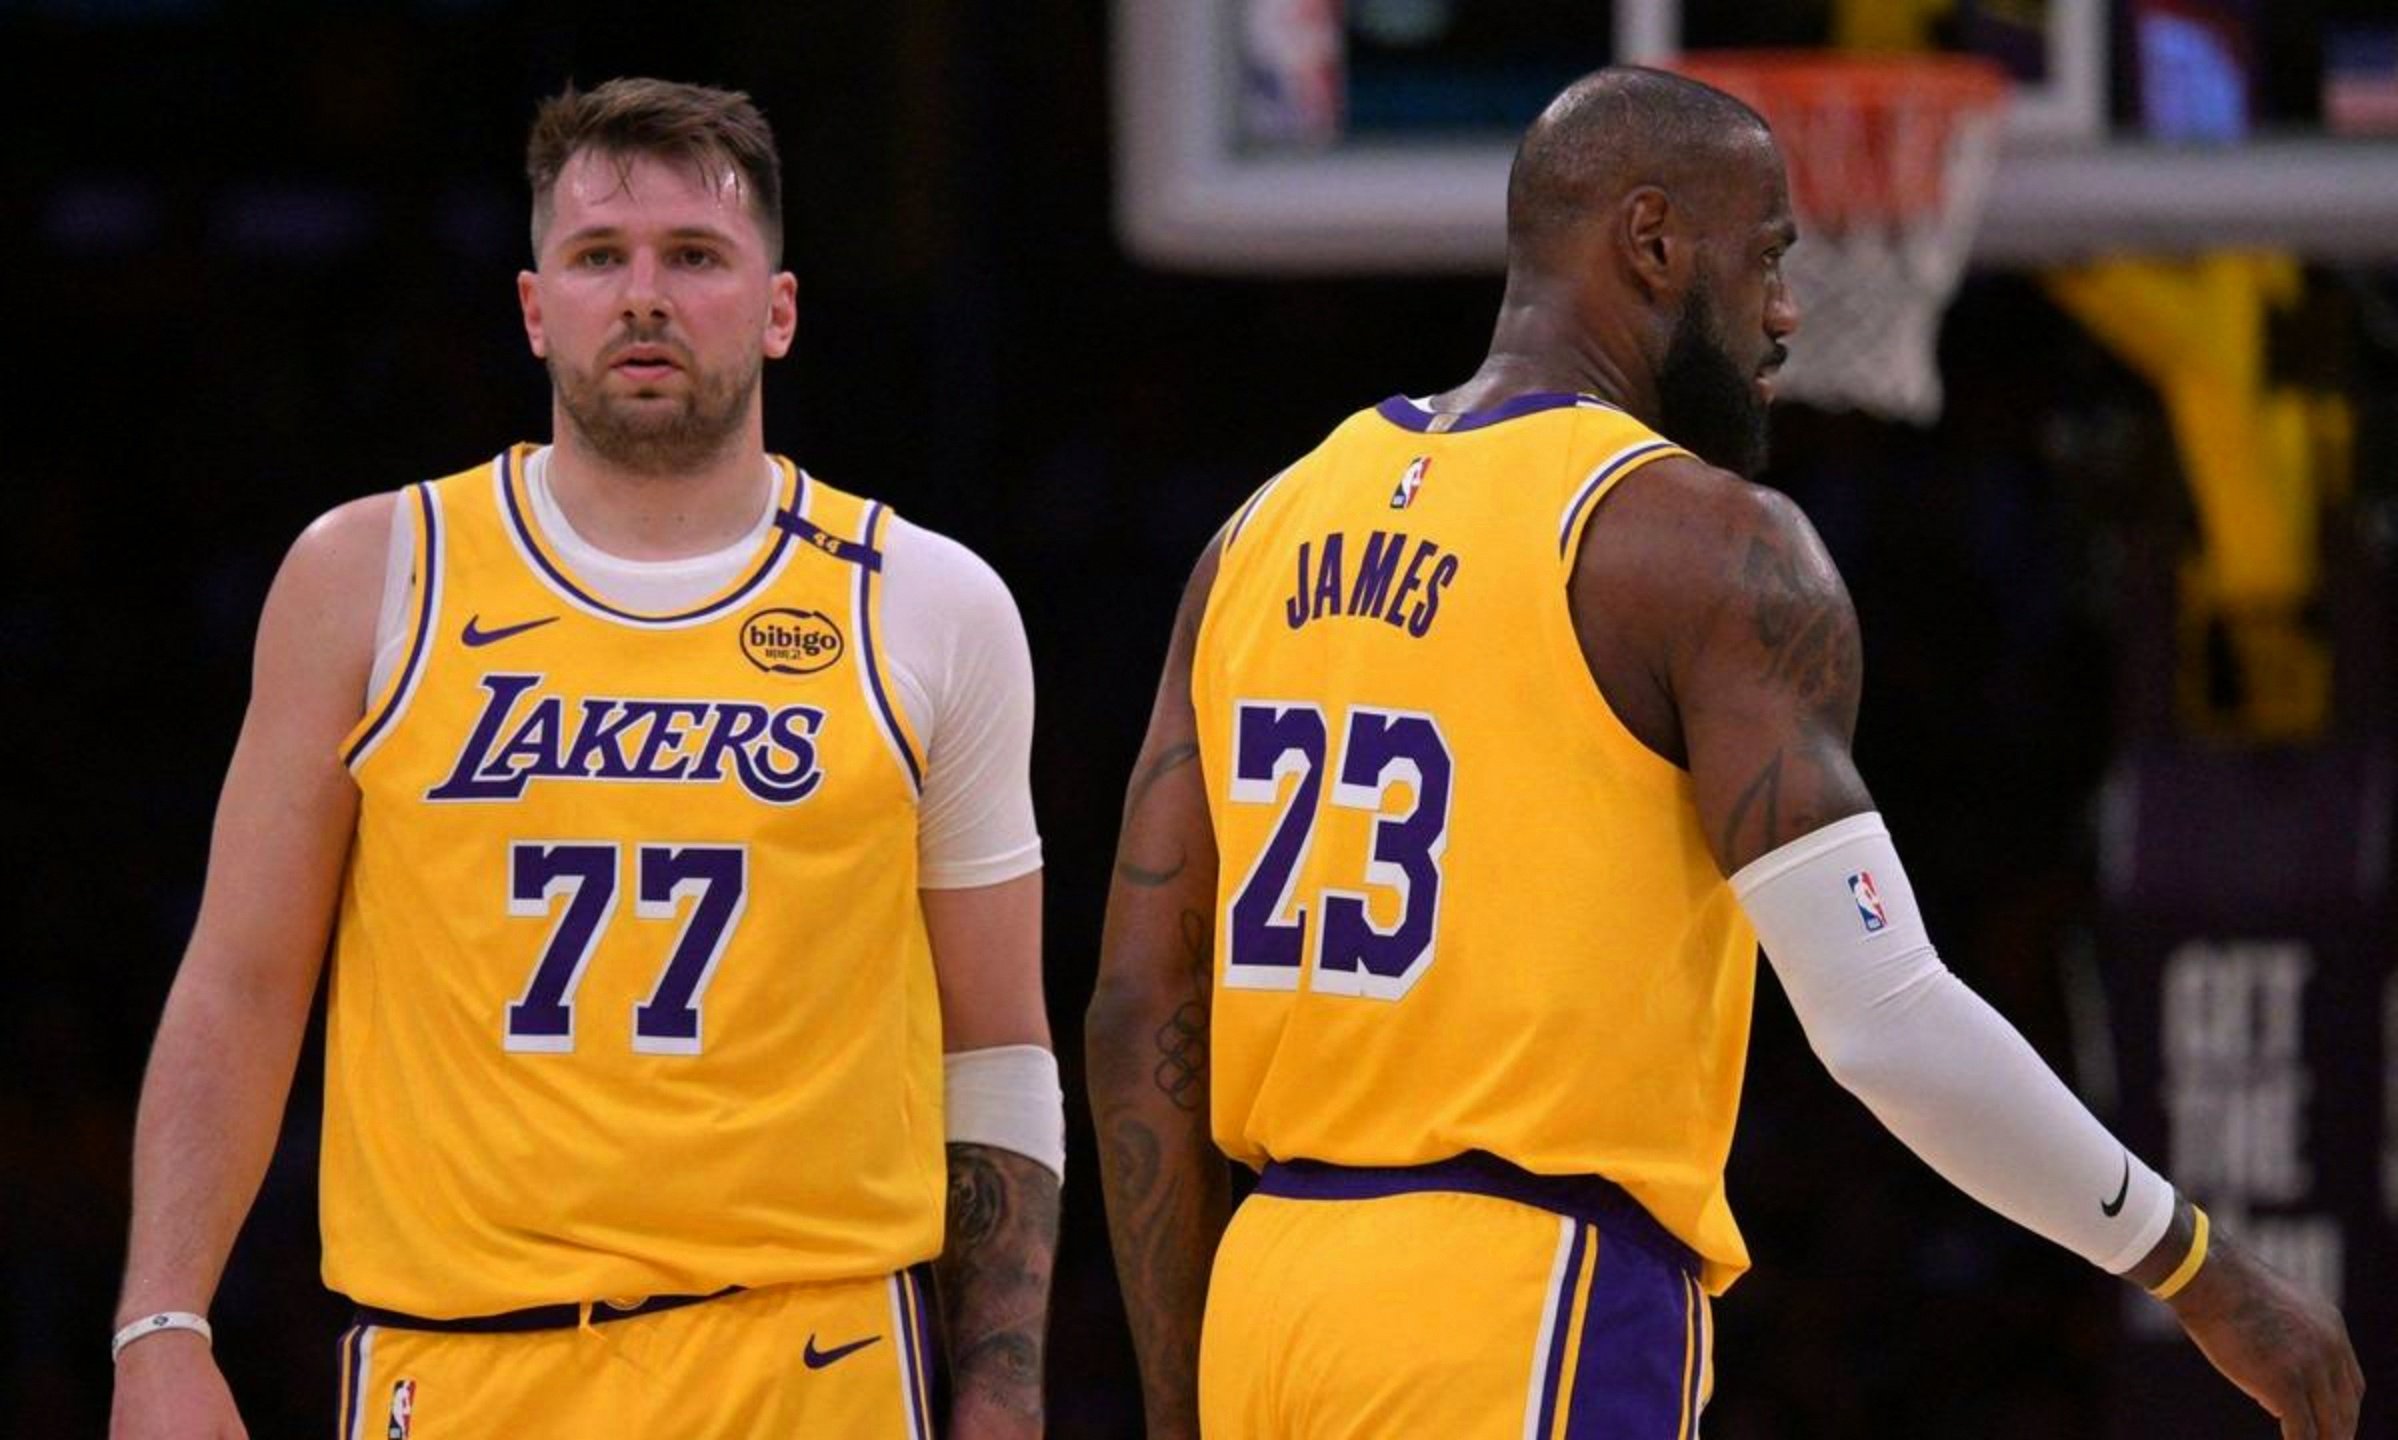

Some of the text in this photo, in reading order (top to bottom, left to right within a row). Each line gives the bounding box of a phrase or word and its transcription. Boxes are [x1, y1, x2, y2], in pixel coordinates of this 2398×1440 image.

[750, 625, 837, 656] bibigo
[1287, 531, 1459, 638] JAMES
[424, 673, 825, 805] LAKERS
[1223, 699, 1454, 1001] 23
[504, 840, 748, 1055] 77
